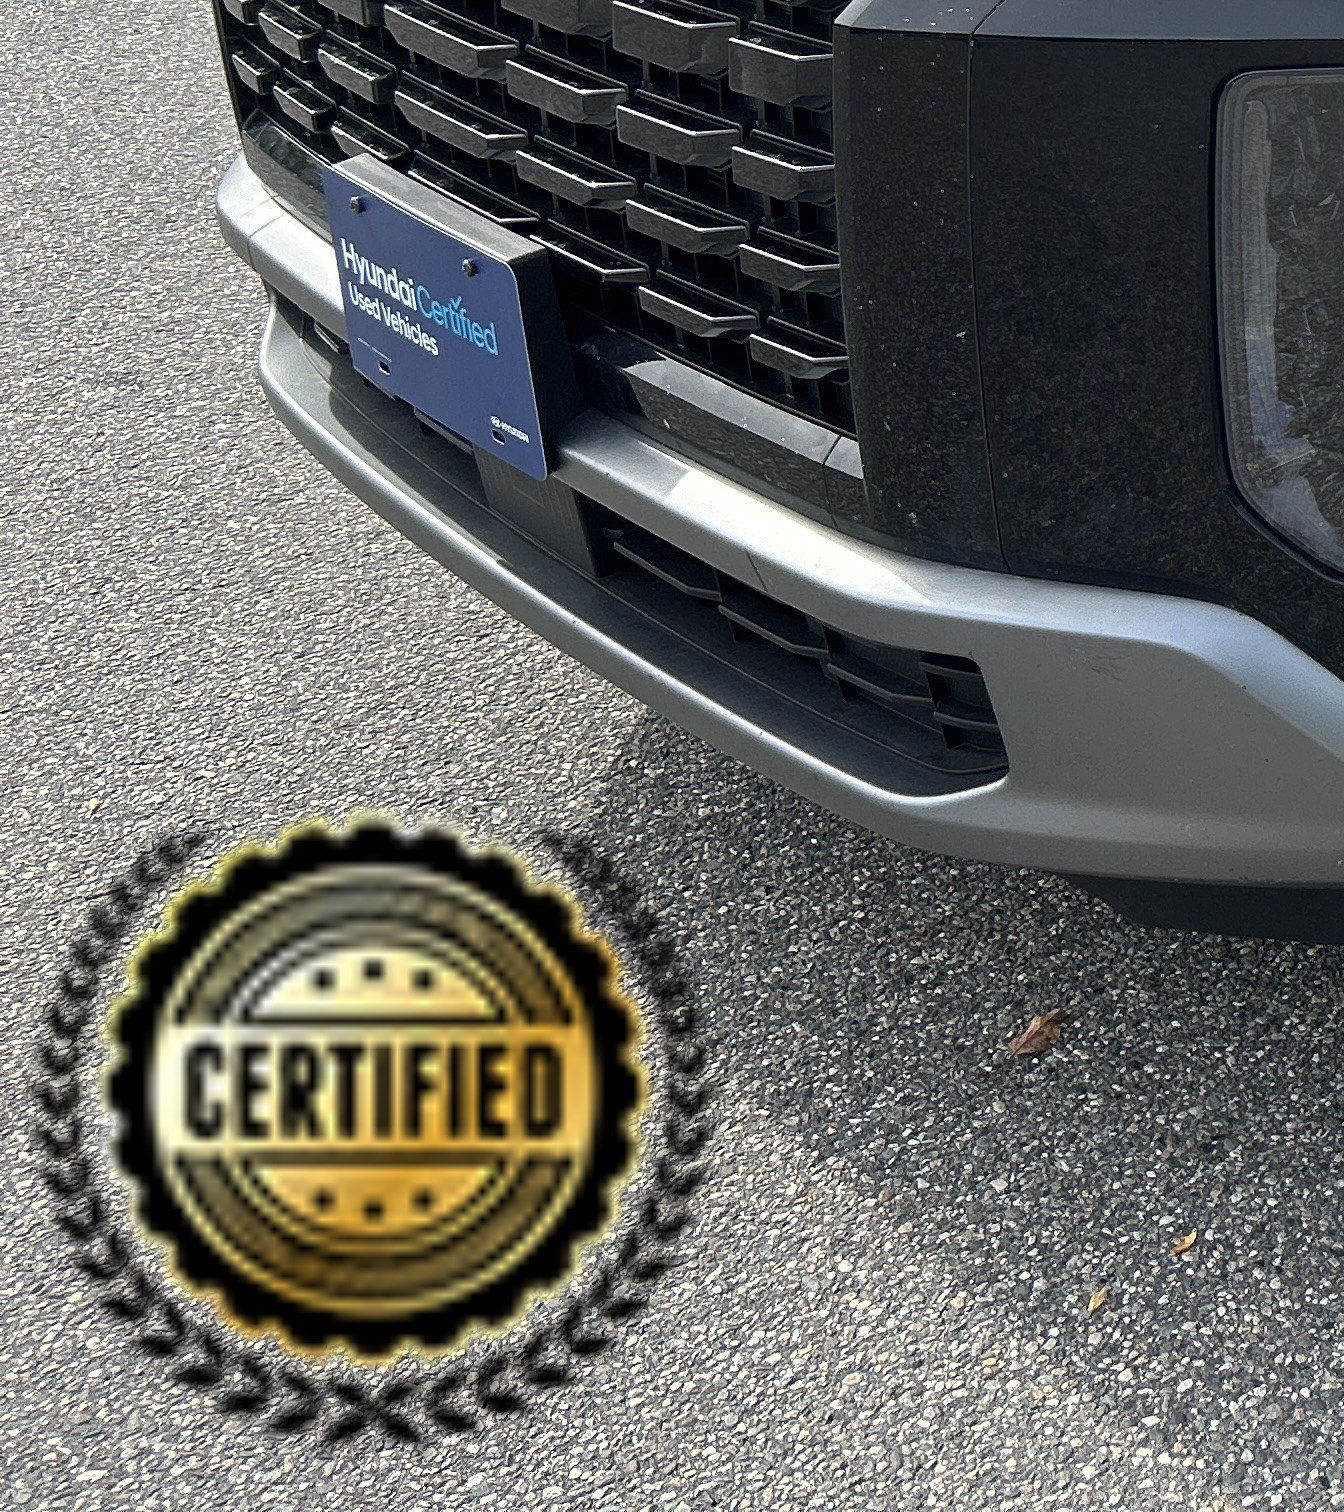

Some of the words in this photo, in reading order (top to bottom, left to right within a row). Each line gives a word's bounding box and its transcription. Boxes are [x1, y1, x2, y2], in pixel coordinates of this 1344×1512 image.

[340, 237, 418, 311] Hyundai
[416, 284, 499, 356] Certified
[347, 281, 382, 322] Used
[380, 301, 439, 356] Vehicles
